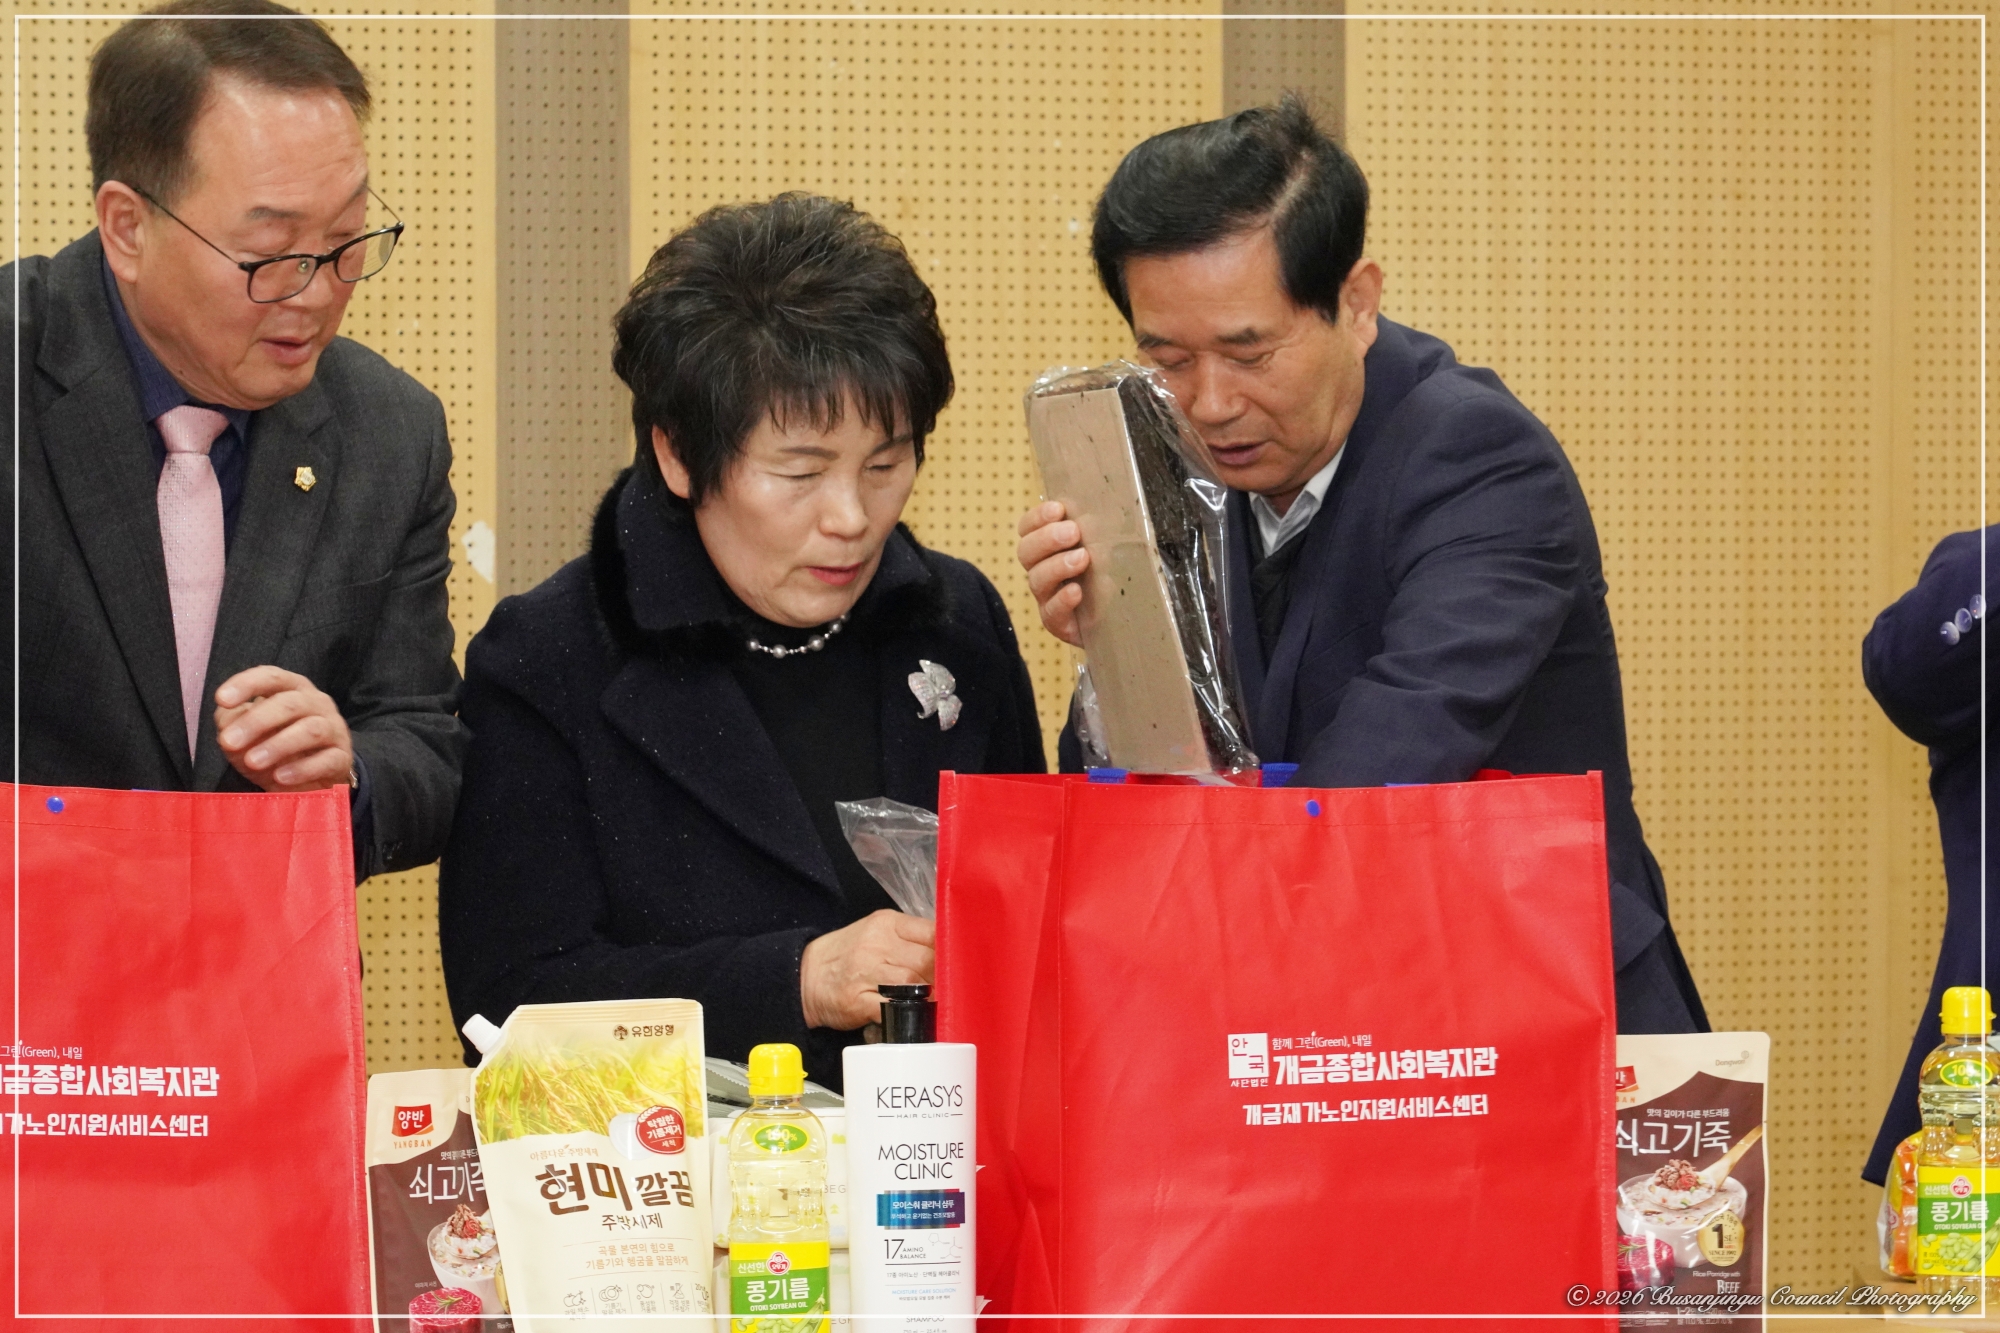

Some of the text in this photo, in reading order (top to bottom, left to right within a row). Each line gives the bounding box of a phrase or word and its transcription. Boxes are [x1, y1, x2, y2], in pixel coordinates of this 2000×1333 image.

[632, 1024, 675, 1037] 유한양행
[1272, 1038, 1293, 1050] 함께
[1352, 1034, 1372, 1047] 내일
[62, 1046, 83, 1060] 내일
[1273, 1046, 1498, 1085] 개금종합사회복지관
[0, 1064, 219, 1097] 금종합사회복지관
[1230, 1078, 1269, 1088] 사단법인
[877, 1085, 963, 1108] KERASYS
[1242, 1094, 1489, 1125] 개금재가노인지원서비스센터
[1647, 1108, 1730, 1119] 맛의 깊이가 다른 부드러움
[0, 1113, 208, 1137] 가노인지원서비스센터
[398, 1110, 425, 1129] 양반
[393, 1139, 432, 1150] YANGBAN
[878, 1142, 963, 1160] MOISTURE
[895, 1162, 953, 1180] CLINIC
[535, 1162, 633, 1216] 현미
[921, 1200, 941, 1209] 클리닉
[942, 1200, 955, 1209] 샴푸
[1931, 1201, 1990, 1222] 콩기름
[602, 1213, 663, 1231] 주방세제
[650, 1243, 675, 1253] 힘으로
[884, 1239, 904, 1259] 17
[737, 1262, 765, 1274] 신선한
[746, 1277, 810, 1303] 콩기름
[1717, 1279, 1741, 1294] BEEF
[750, 1304, 769, 1312] OTOKI
[769, 1302, 797, 1310] SOYBEAN
